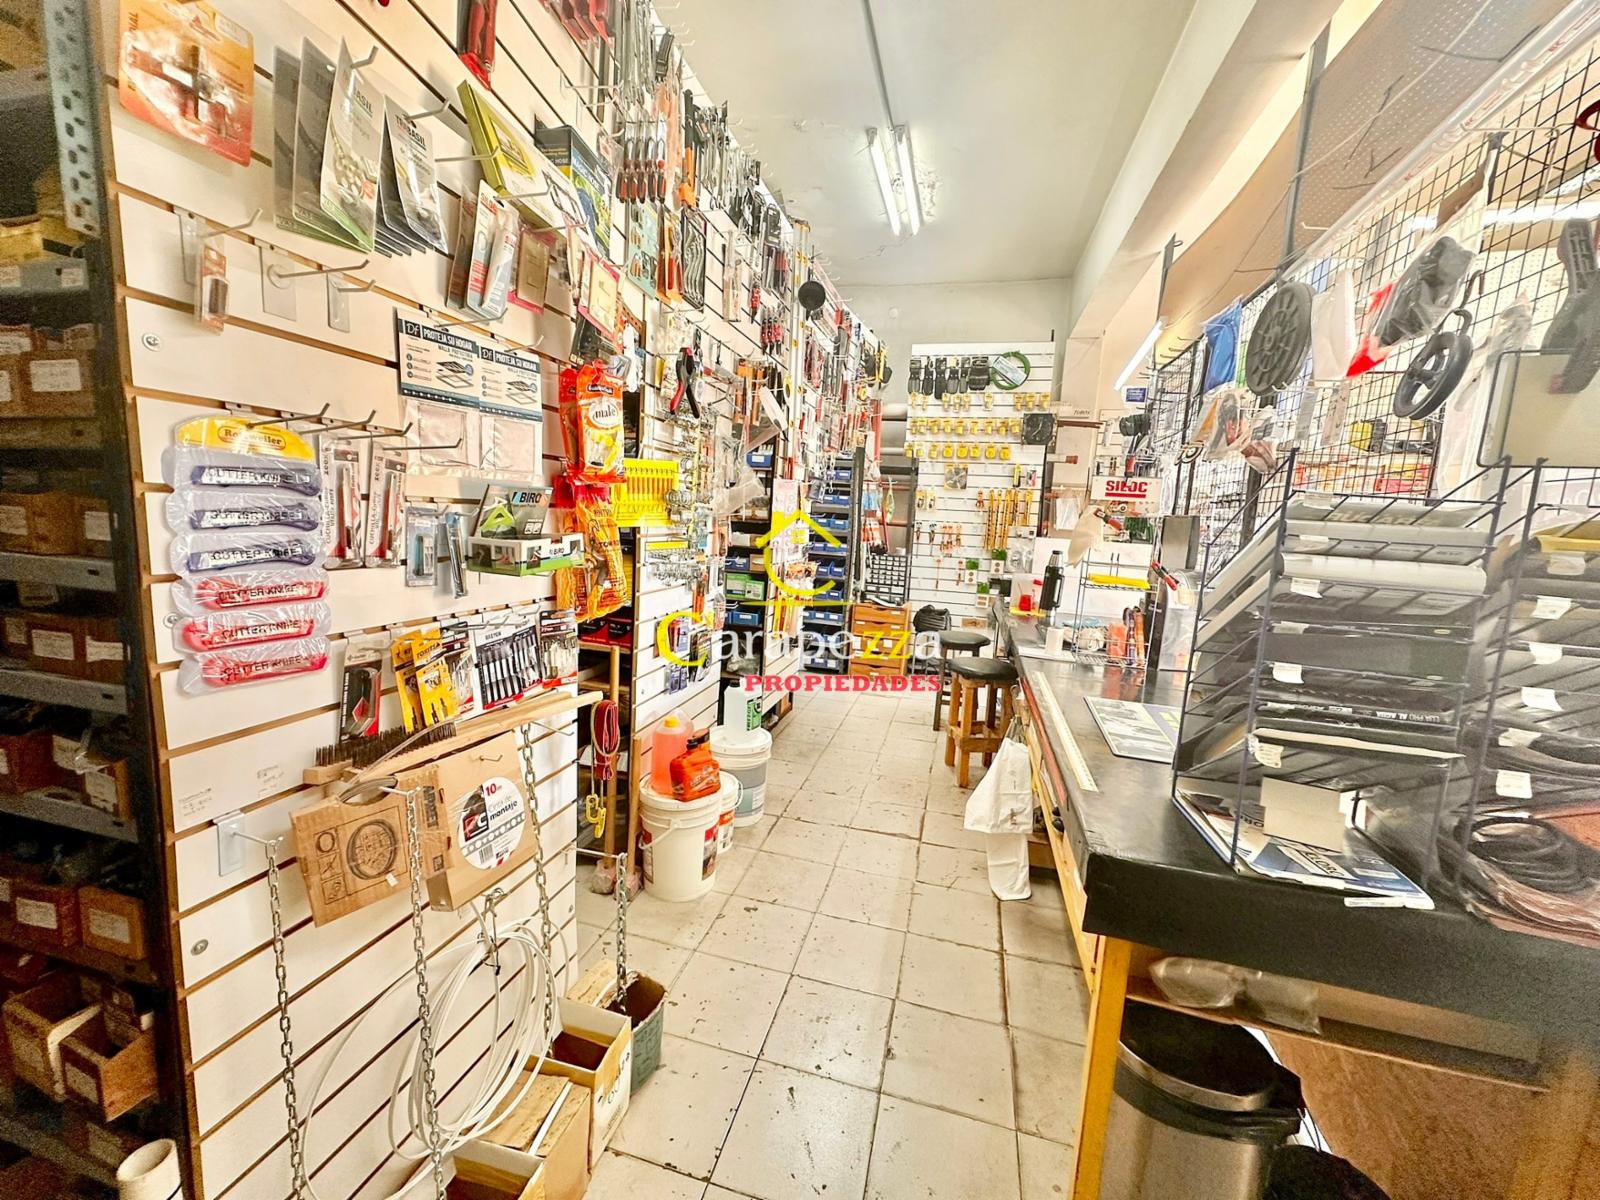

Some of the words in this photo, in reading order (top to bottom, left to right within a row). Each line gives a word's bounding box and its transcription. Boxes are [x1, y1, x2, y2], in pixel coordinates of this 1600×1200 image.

[423, 328, 447, 344] PROTEJA
[447, 335, 455, 345] SU
[455, 337, 473, 351] HOGAR
[495, 354, 515, 366] PROTEJA
[486, 783, 497, 797] 10
